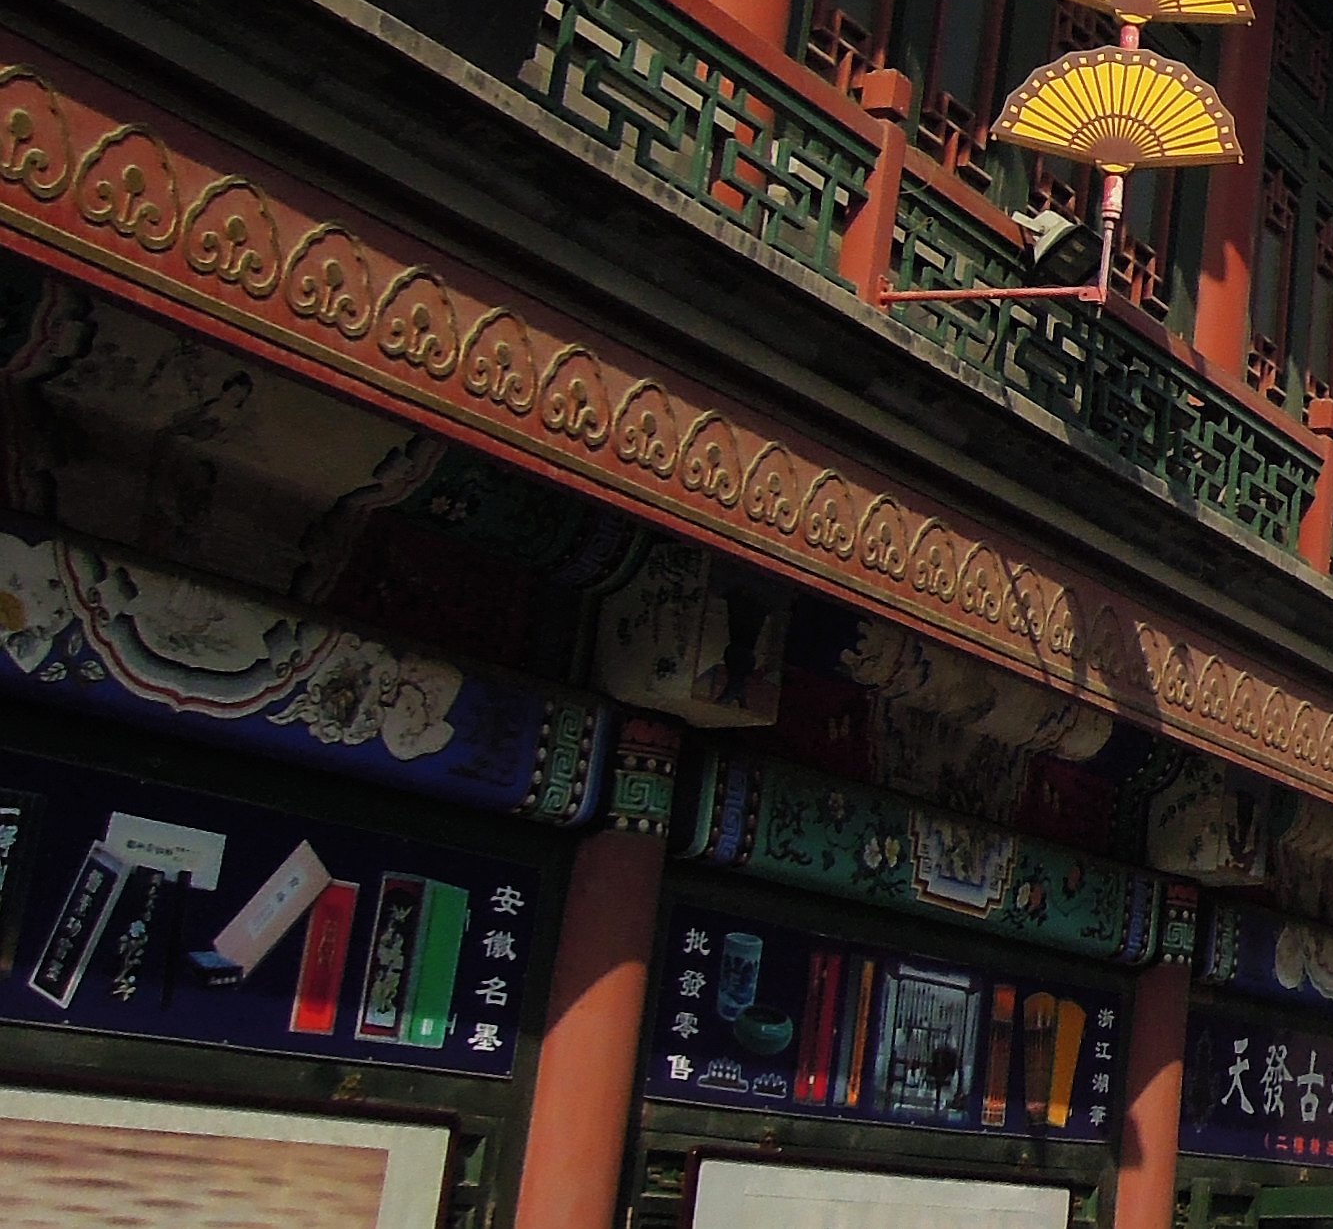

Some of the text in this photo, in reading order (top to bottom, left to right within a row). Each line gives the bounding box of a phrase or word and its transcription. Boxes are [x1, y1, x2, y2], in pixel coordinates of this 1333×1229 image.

[467, 885, 525, 1052] 安徽名墨
[666, 928, 711, 1083] 批發零售
